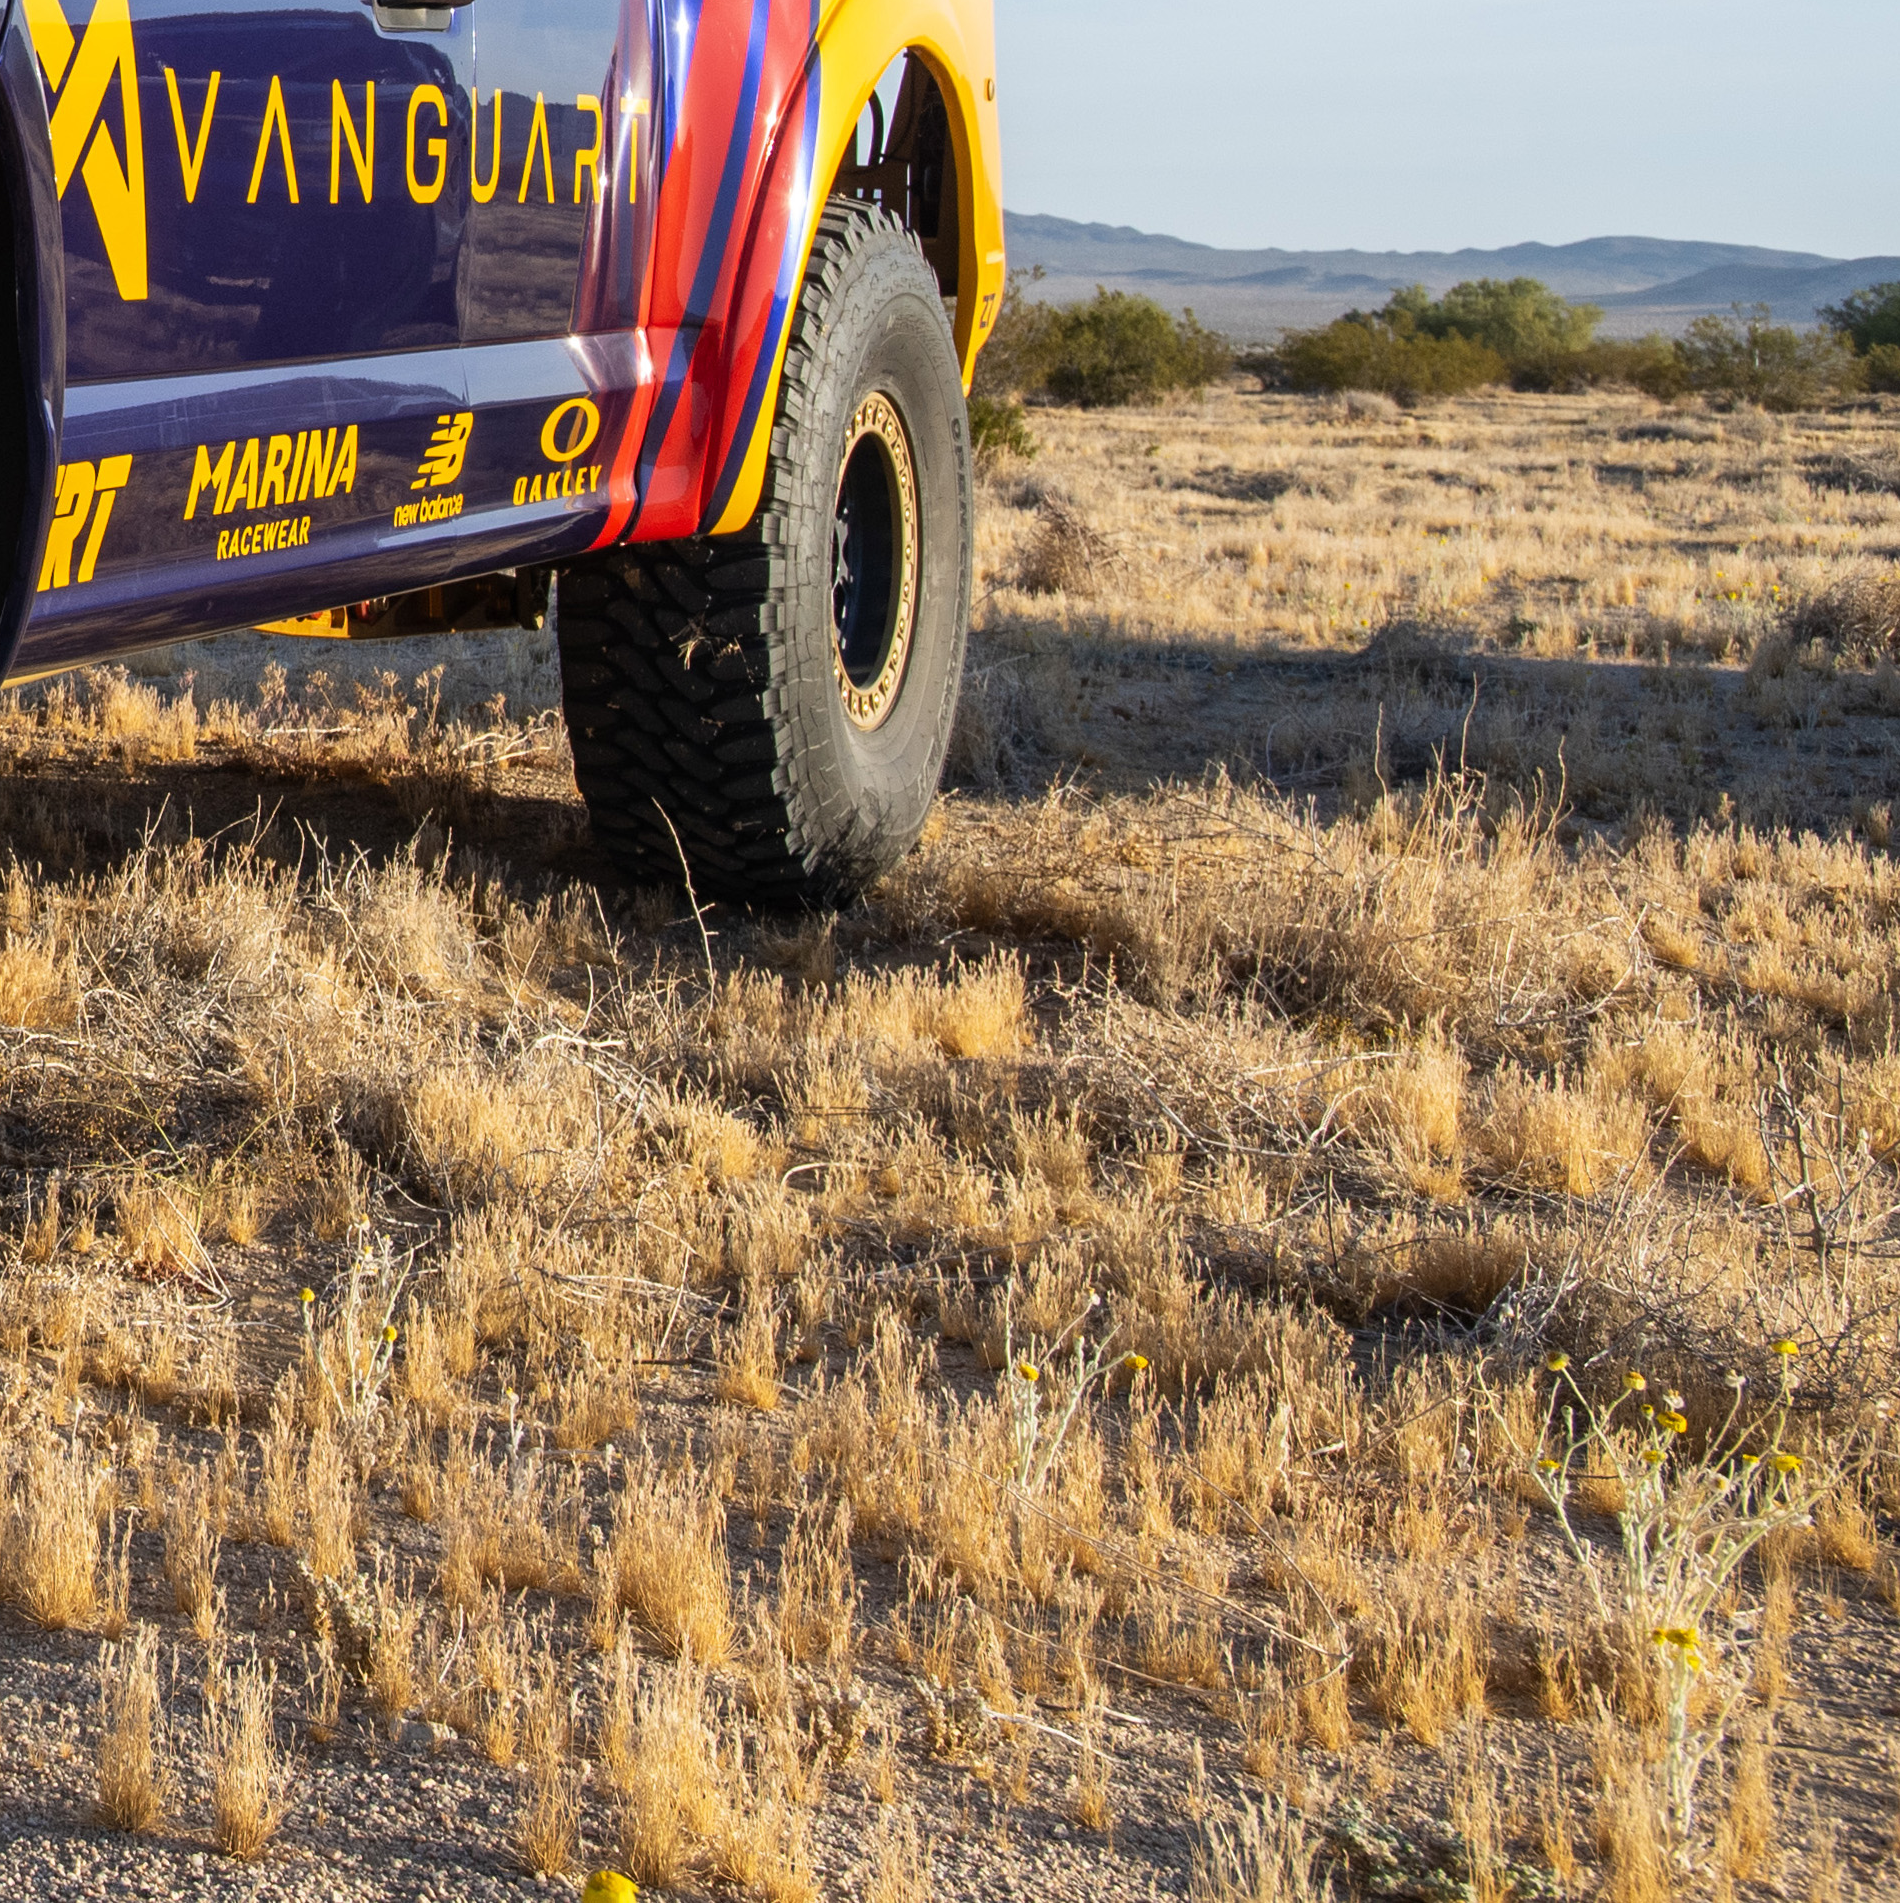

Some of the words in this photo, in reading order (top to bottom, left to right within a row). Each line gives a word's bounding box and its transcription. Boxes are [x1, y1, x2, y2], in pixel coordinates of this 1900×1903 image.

[164, 66, 650, 205] VANGUART
[183, 424, 358, 520] MARINA
[513, 464, 602, 506] OAKLEY
[36, 453, 133, 593] RT
[216, 515, 311, 561] RACEWEAR
[393, 503, 420, 528] new
